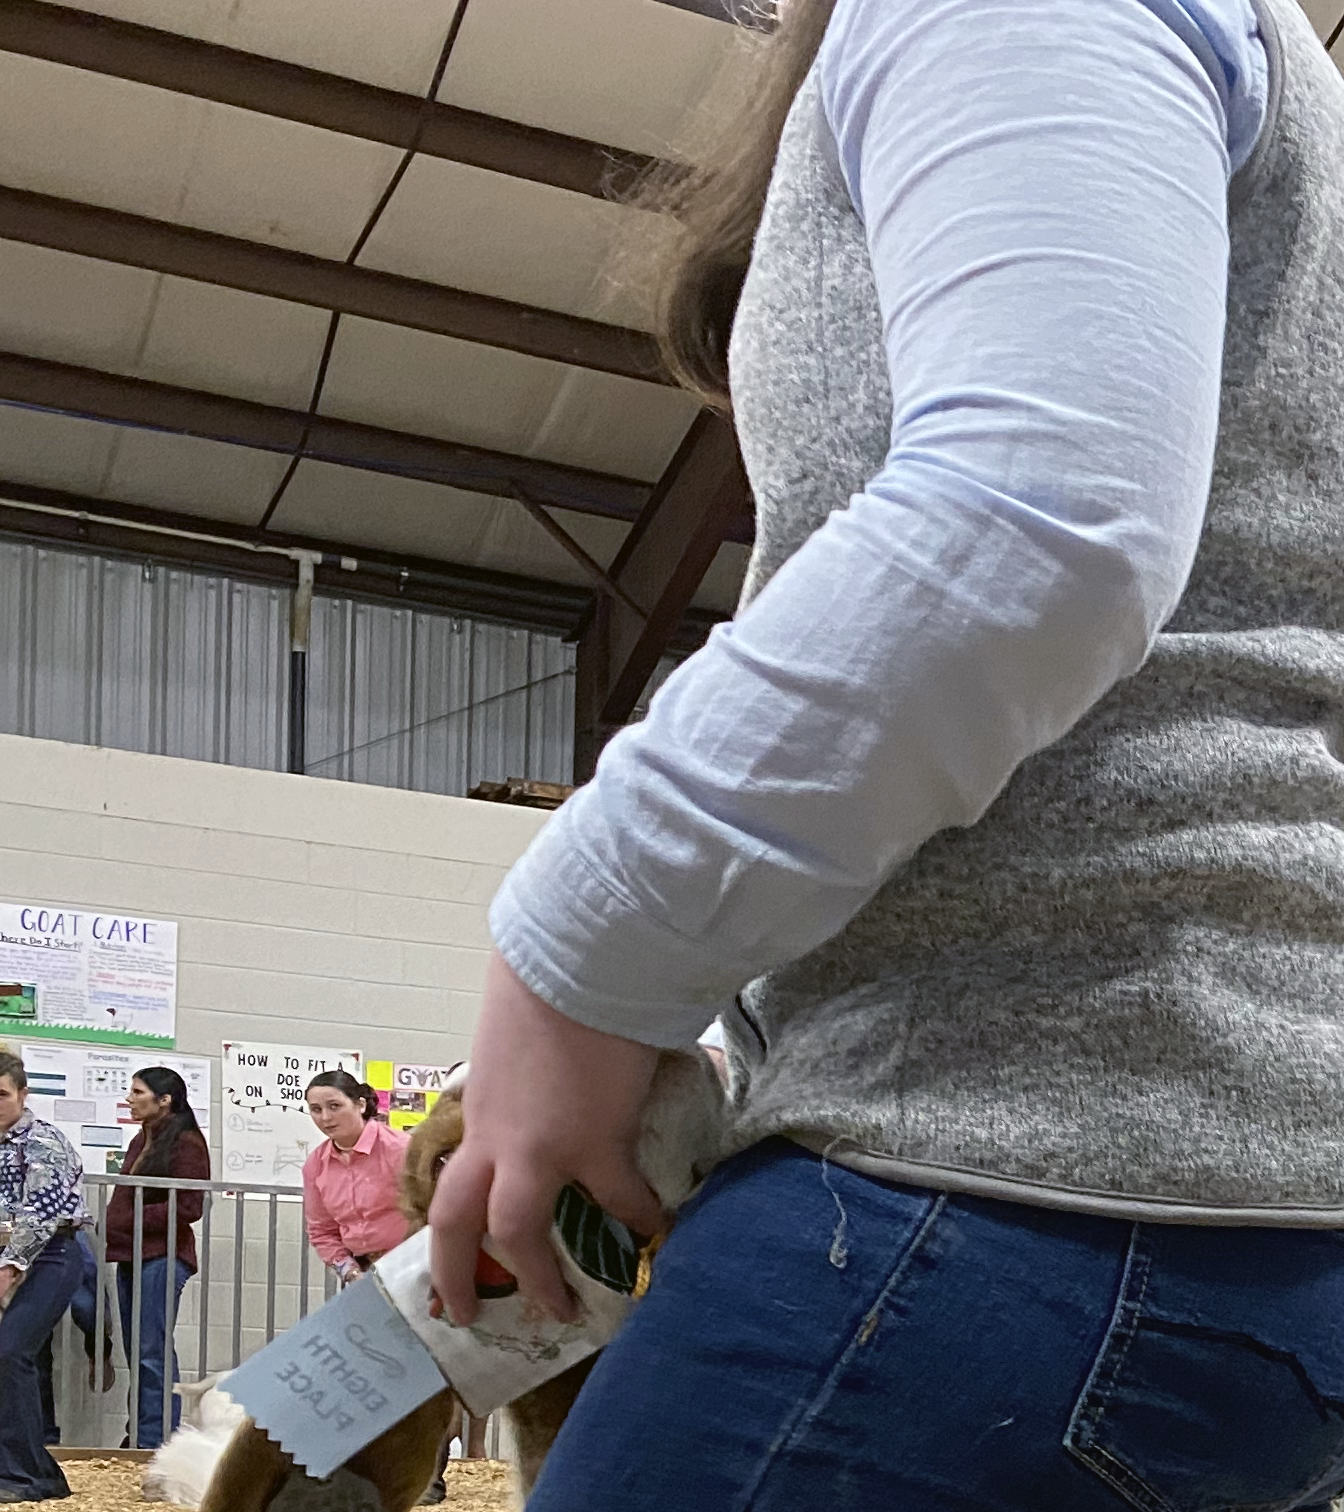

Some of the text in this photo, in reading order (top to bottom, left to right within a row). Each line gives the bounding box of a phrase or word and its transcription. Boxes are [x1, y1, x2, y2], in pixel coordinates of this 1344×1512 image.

[21, 908, 157, 945] GOAT CARE
[0, 932, 26, 944] here
[29, 936, 42, 945] Do
[44, 937, 51, 947] I
[87, 1052, 129, 1063] Parasites
[237, 1053, 344, 1072] HOW TO FIT A
[277, 1073, 300, 1087] DOE
[245, 1085, 303, 1101] ON SHO
